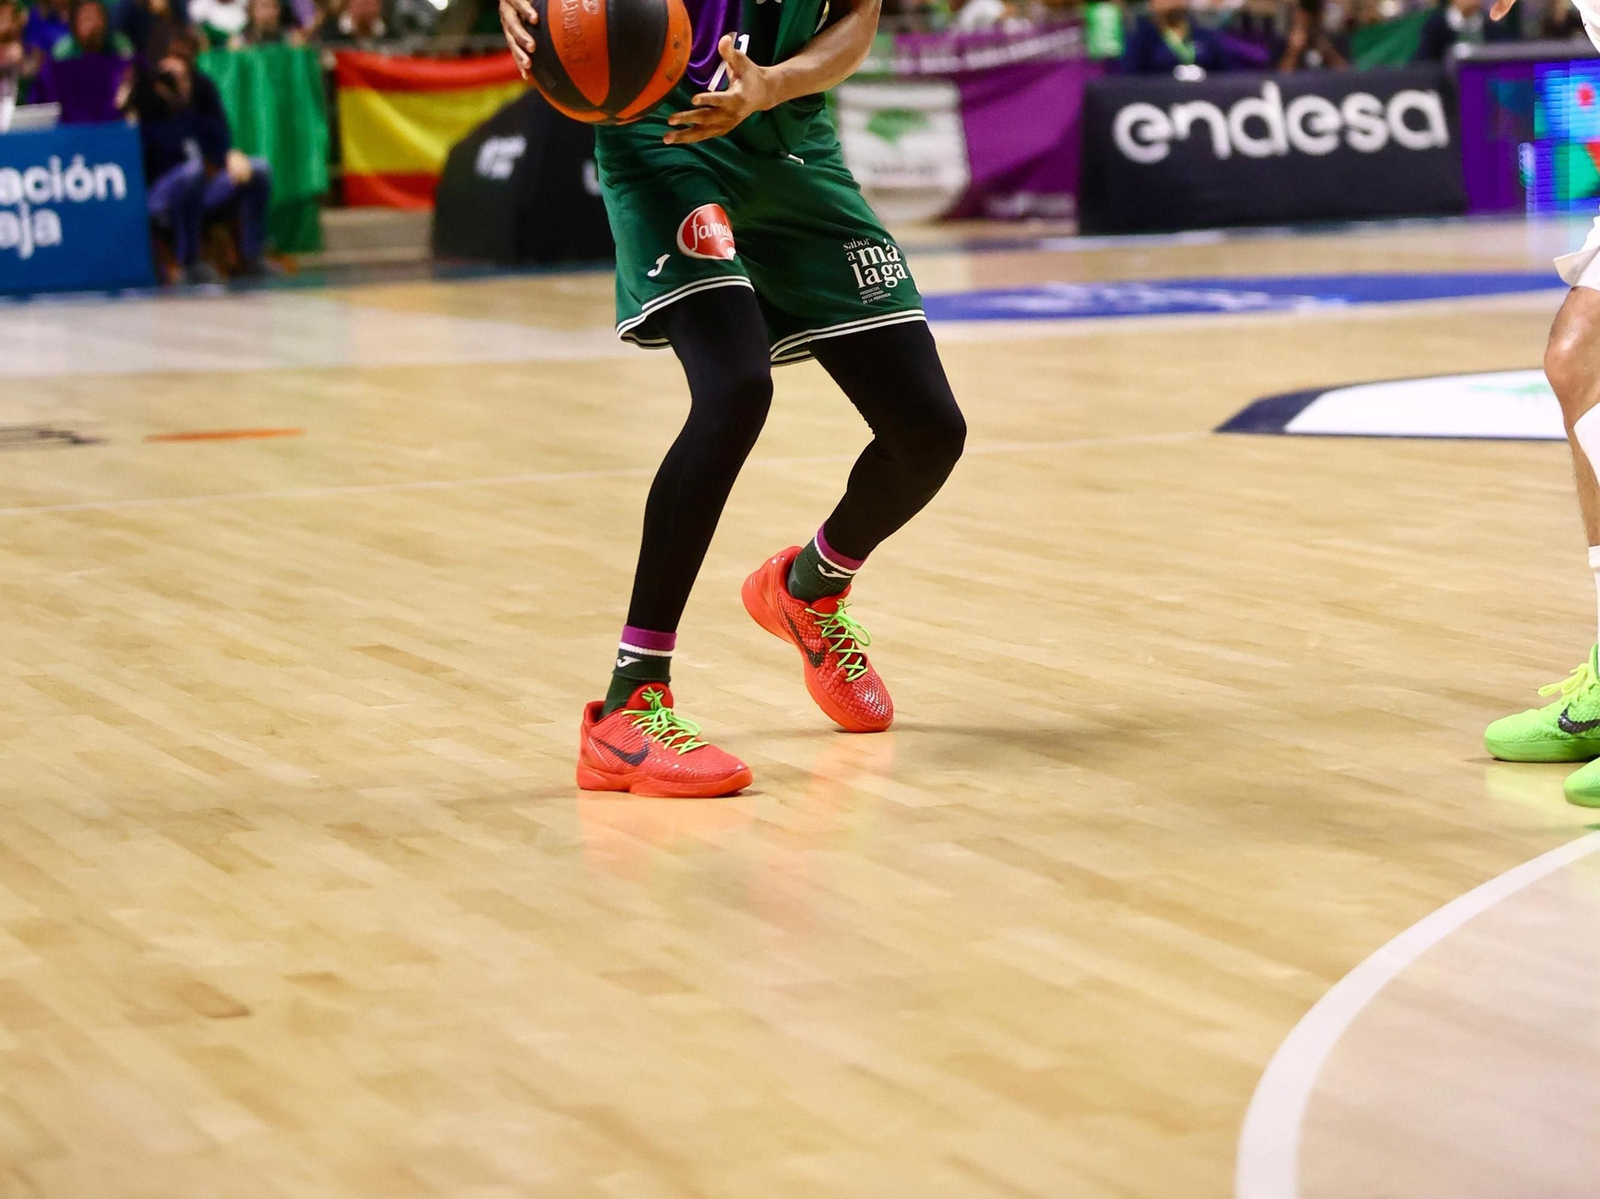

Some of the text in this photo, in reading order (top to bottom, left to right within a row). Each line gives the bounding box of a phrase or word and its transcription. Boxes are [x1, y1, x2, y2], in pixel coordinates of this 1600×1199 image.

[1112, 79, 1449, 164] endesa
[843, 237, 870, 250] sabor
[851, 262, 908, 288] laga
